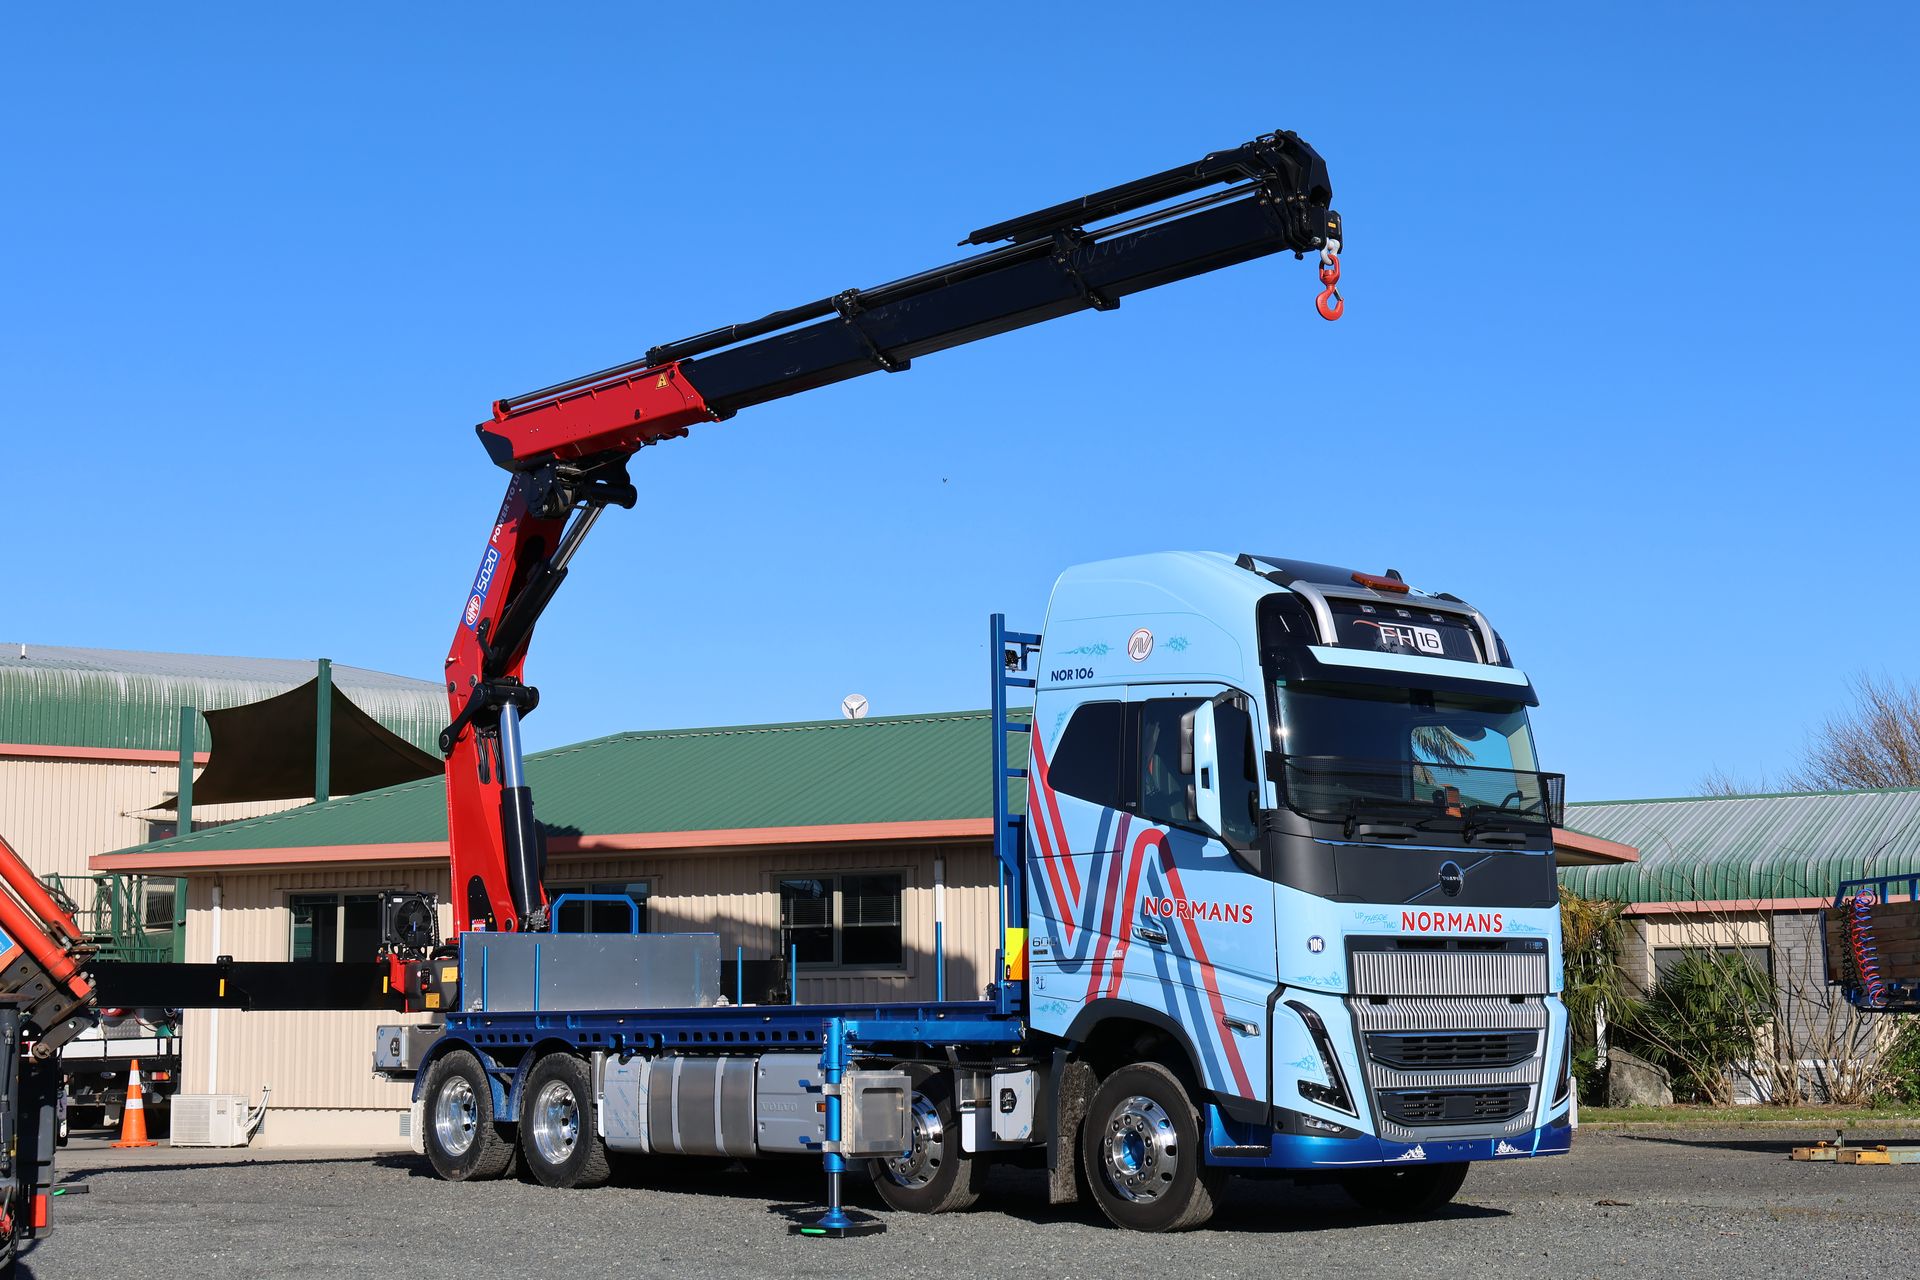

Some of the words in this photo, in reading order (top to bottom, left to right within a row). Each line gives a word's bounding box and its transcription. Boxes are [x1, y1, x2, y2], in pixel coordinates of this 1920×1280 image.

[492, 505, 509, 543] POWER
[507, 487, 516, 502] TO
[466, 595, 480, 623] HMF
[477, 548, 498, 592] 5020
[1051, 669, 1074, 681] NOR
[1075, 667, 1094, 680] 106
[1144, 896, 1253, 924] NORMANS
[1401, 911, 1503, 933] NORMANS
[1310, 939, 1322, 951] 106
[823, 1034, 828, 1044] 2
